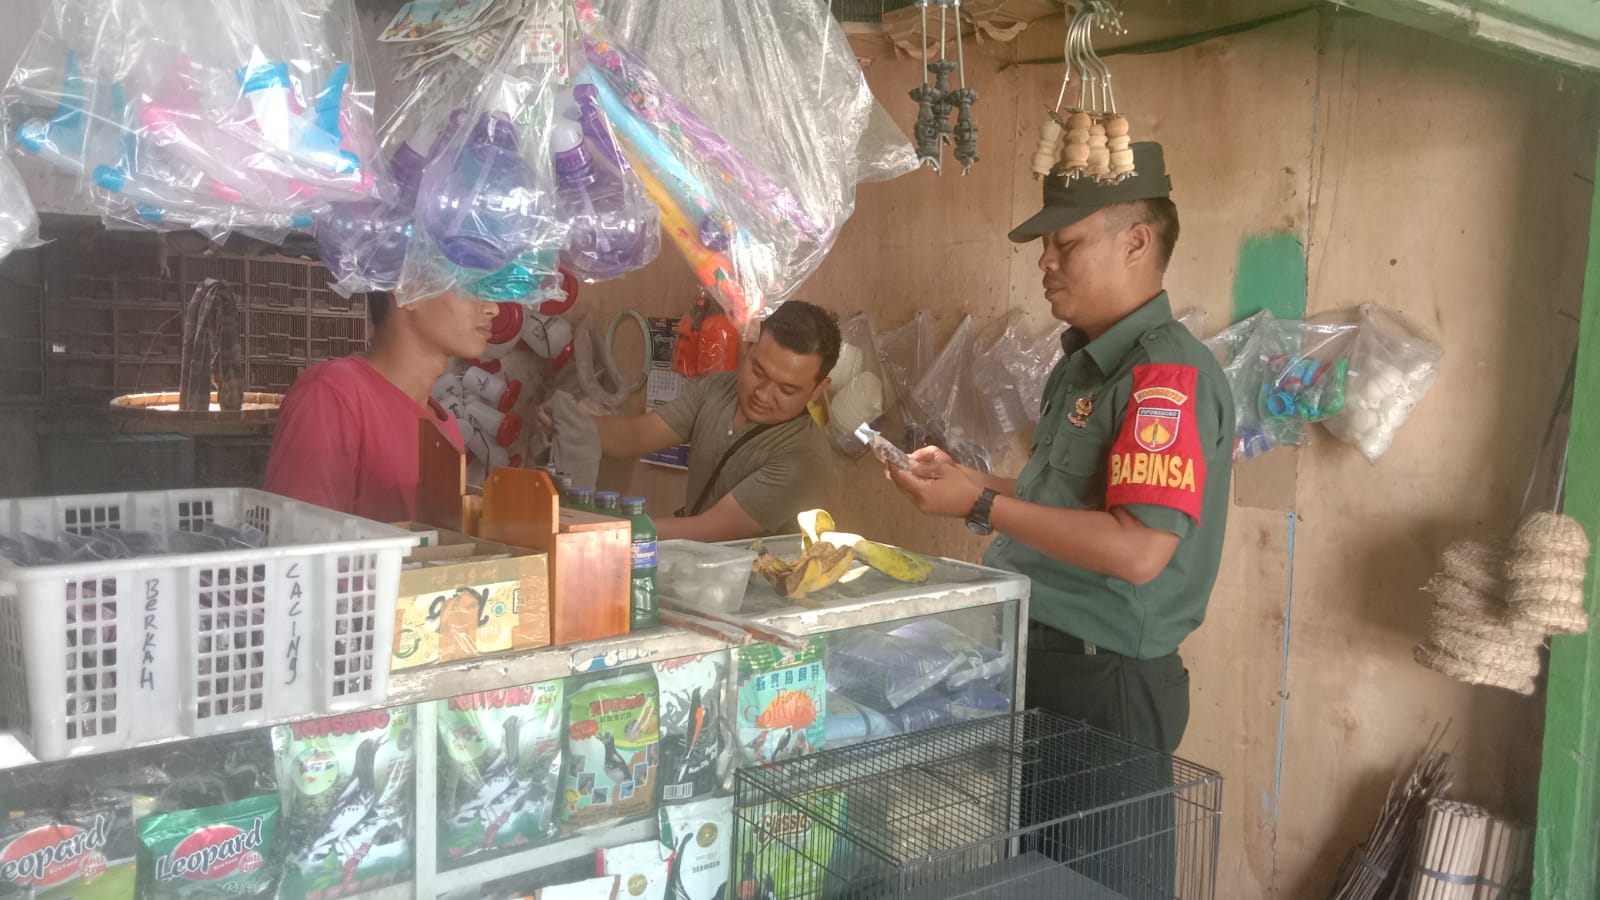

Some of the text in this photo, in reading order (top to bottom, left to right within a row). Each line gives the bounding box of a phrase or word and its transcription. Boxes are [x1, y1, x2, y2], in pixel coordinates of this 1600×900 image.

[1111, 452, 1196, 493] BABINSA
[0, 815, 107, 881] eopard
[155, 817, 264, 882] Leopard
